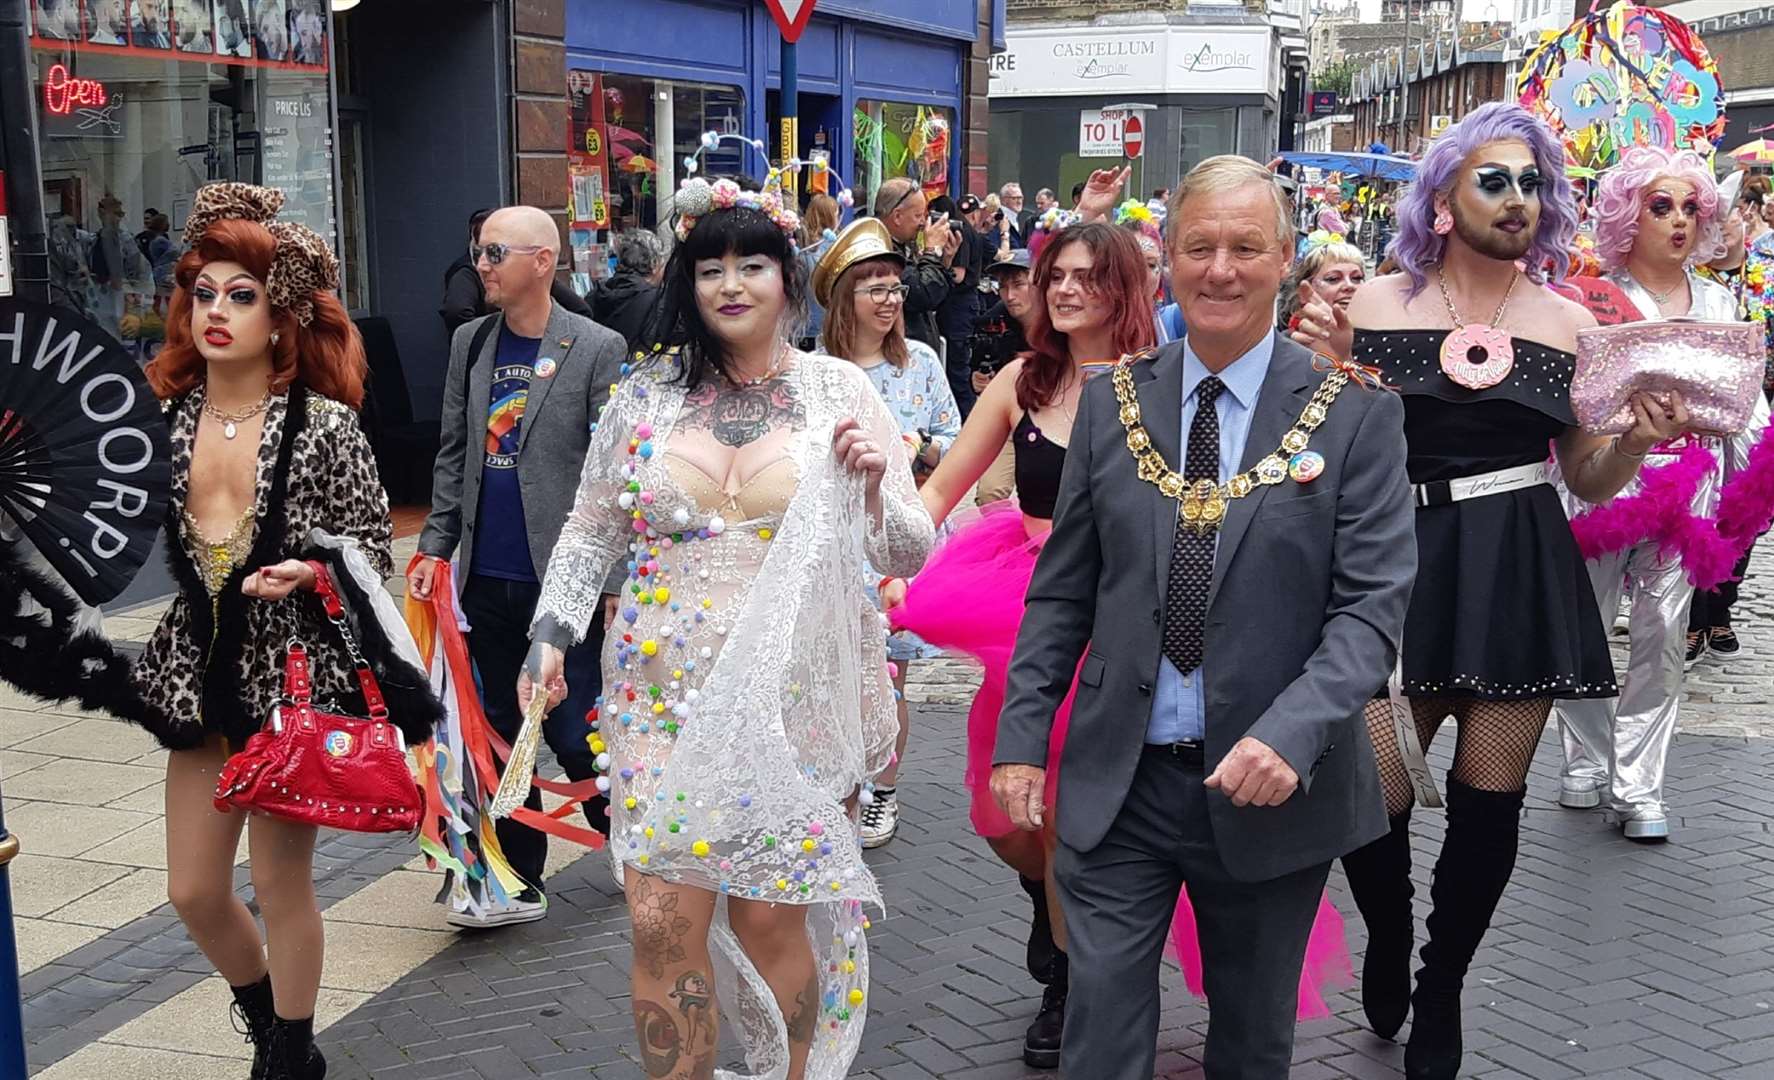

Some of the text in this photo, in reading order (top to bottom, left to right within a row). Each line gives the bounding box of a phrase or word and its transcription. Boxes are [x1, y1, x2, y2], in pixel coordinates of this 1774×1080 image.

[1053, 40, 1155, 57] CASTELLUM
[47, 64, 106, 114] Open
[275, 100, 299, 116] PRICE
[1100, 110, 1124, 121] SHOP
[1084, 123, 1106, 142] TO
